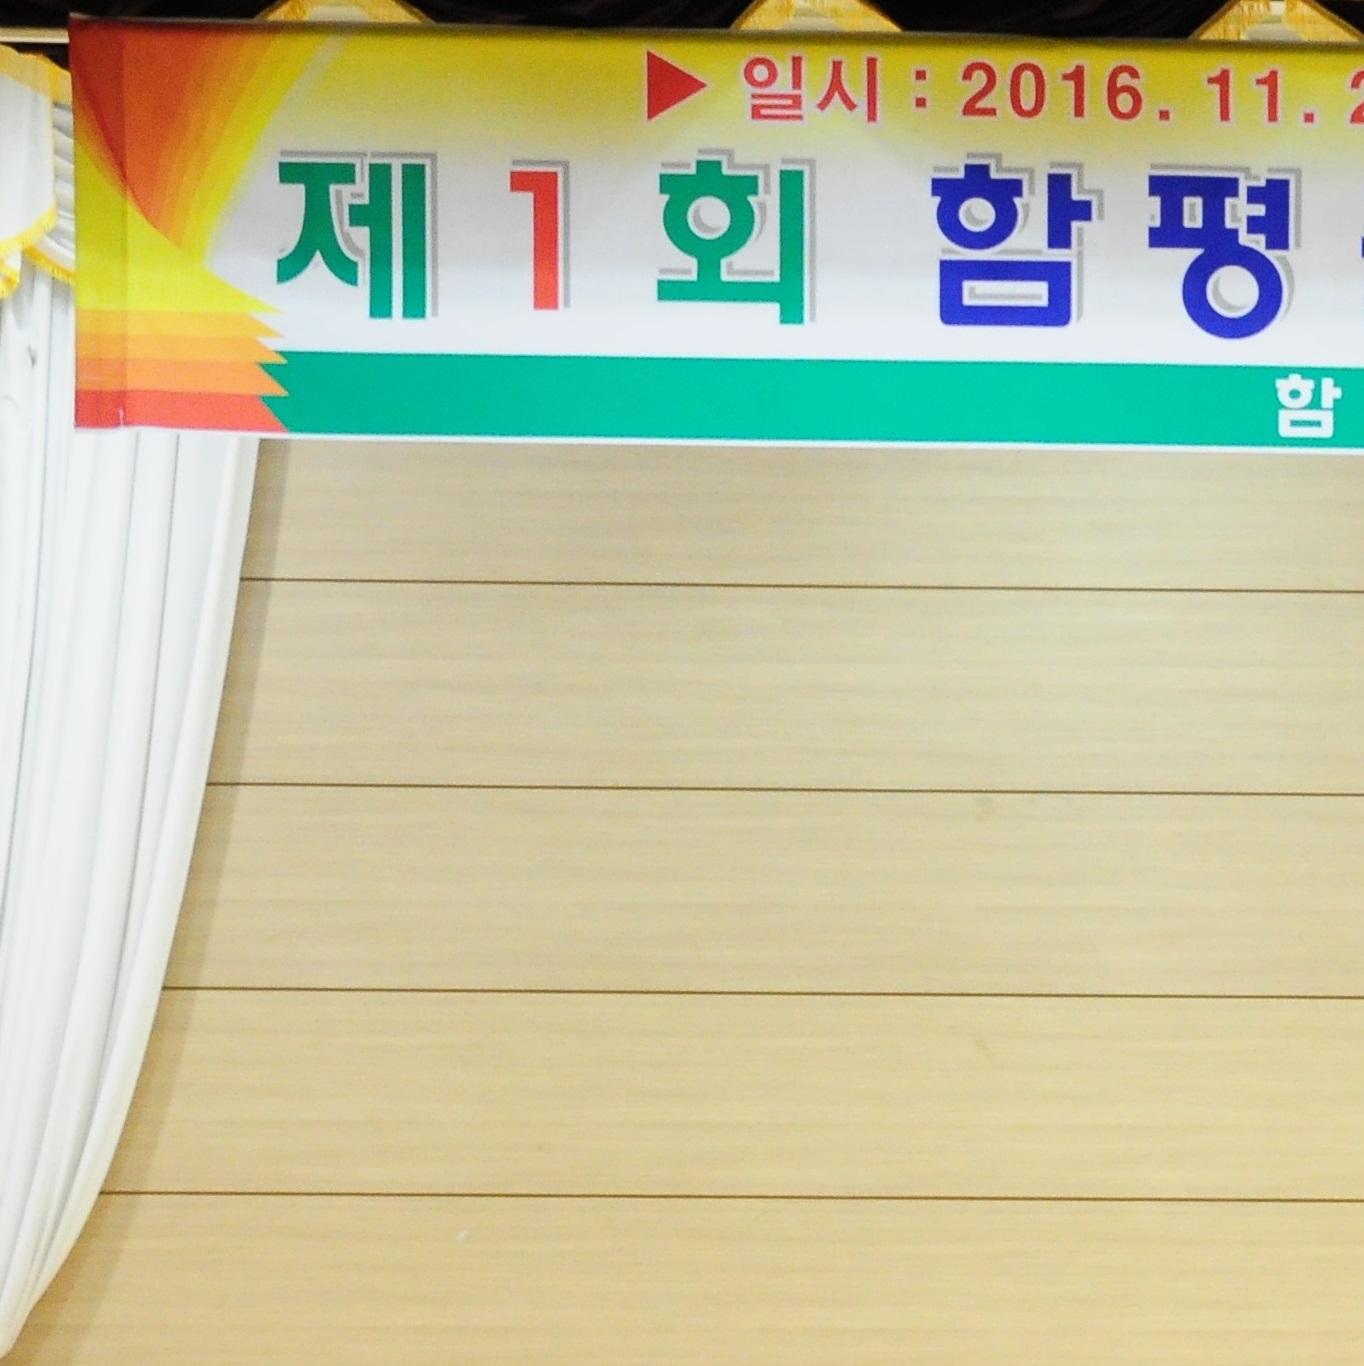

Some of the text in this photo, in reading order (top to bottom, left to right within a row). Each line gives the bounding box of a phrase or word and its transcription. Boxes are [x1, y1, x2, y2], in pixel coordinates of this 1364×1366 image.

[744, 55, 879, 122] 일시
[961, 61, 1172, 121] 2016.
[1208, 68, 1316, 124] 11.
